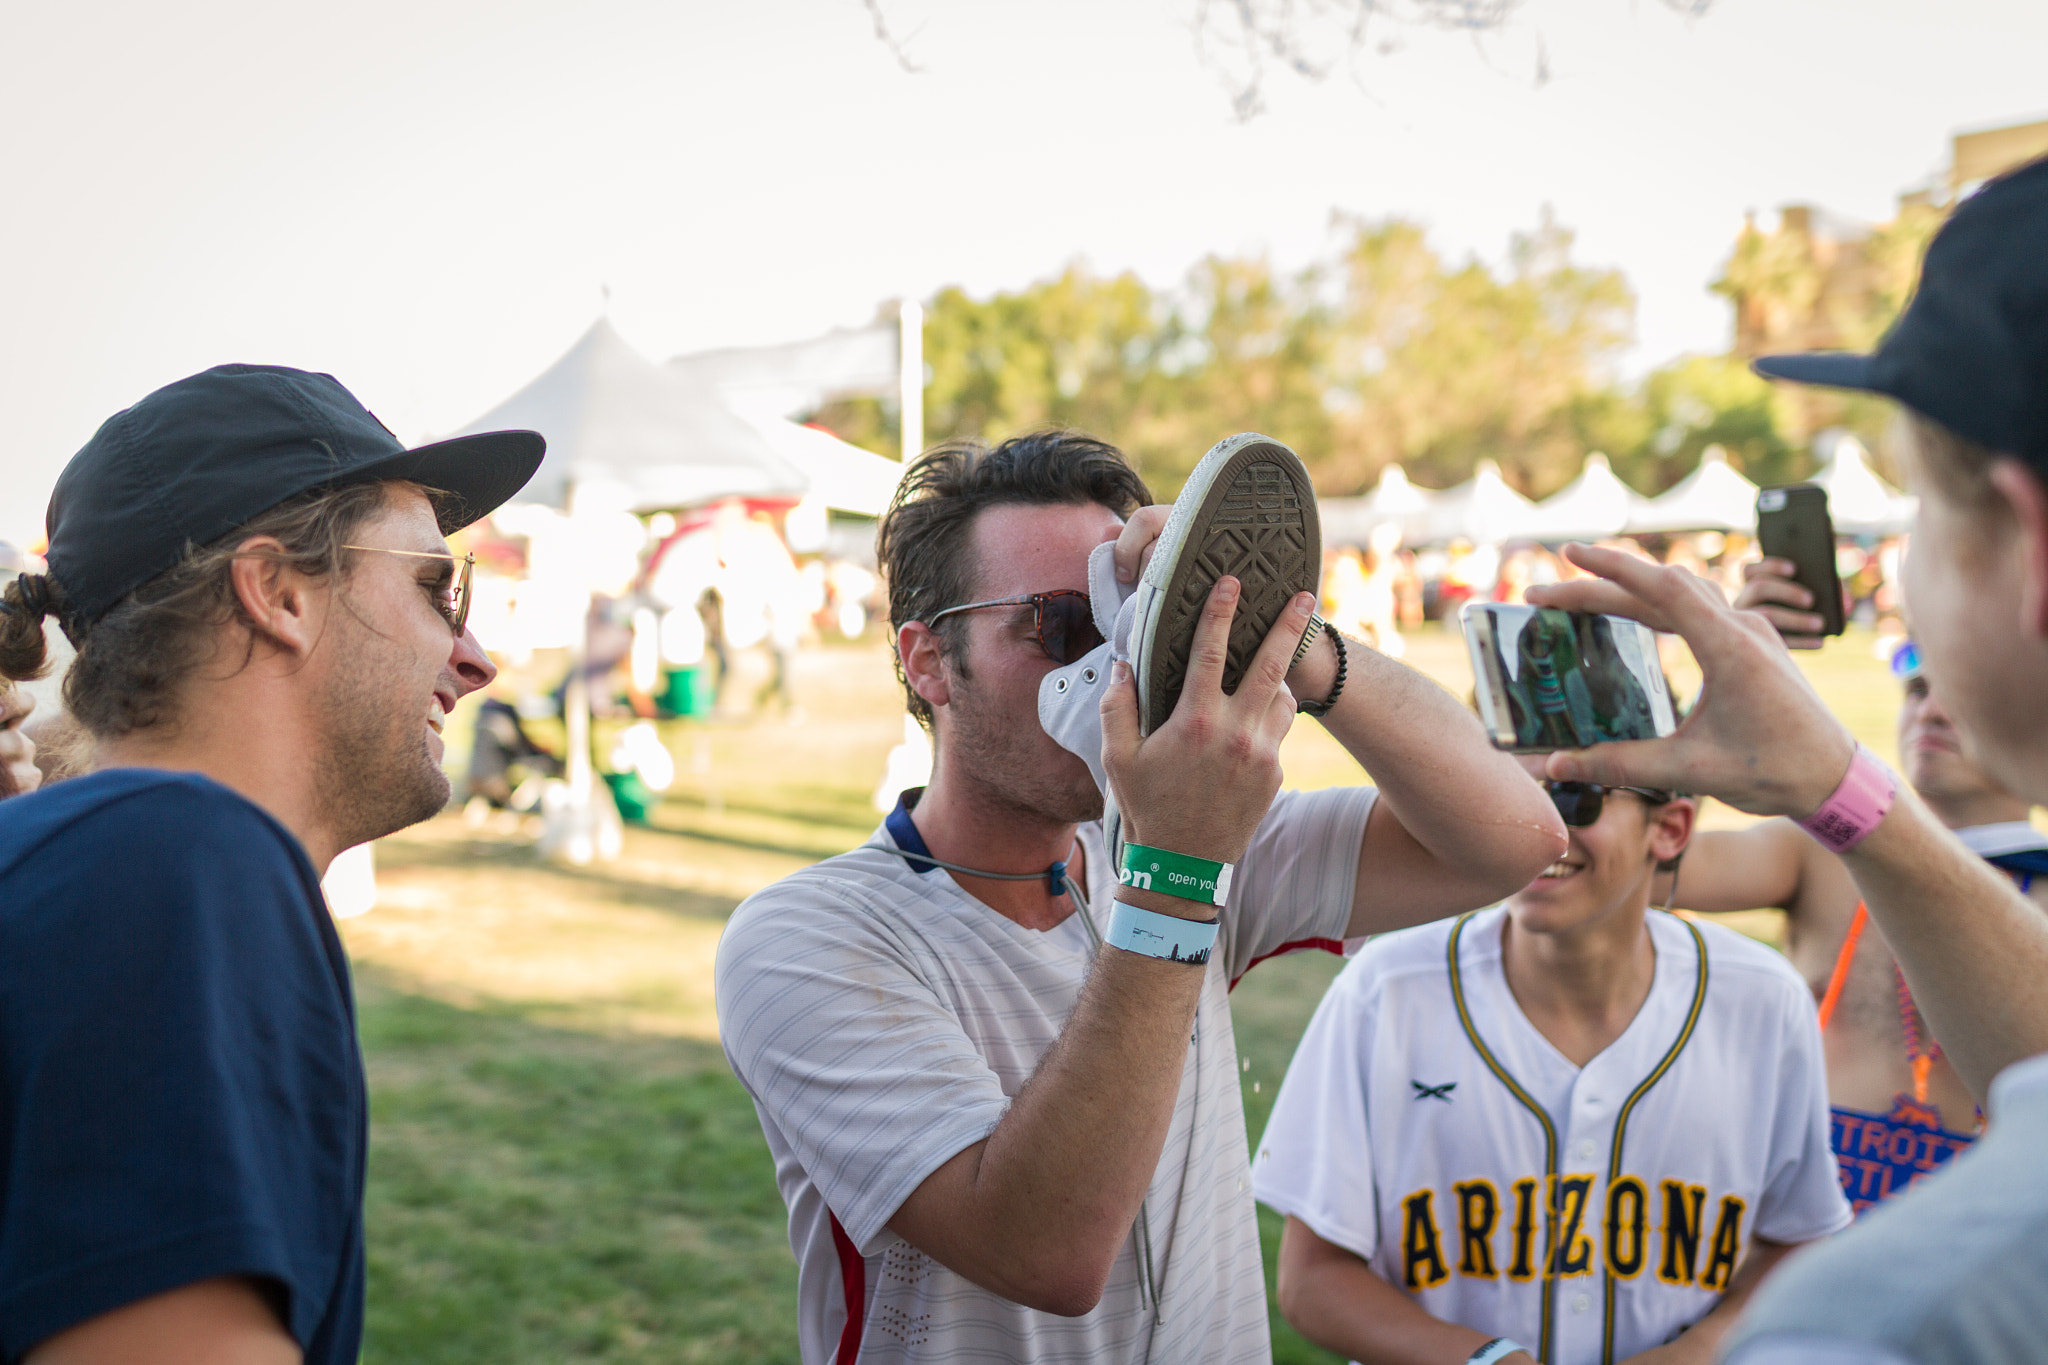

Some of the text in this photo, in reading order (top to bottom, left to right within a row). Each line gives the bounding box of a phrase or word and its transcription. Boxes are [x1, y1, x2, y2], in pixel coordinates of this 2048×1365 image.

[1168, 872, 1197, 887] open
[1830, 1111, 1973, 1170] TROIT
[1401, 1173, 1746, 1292] ARIZONA
